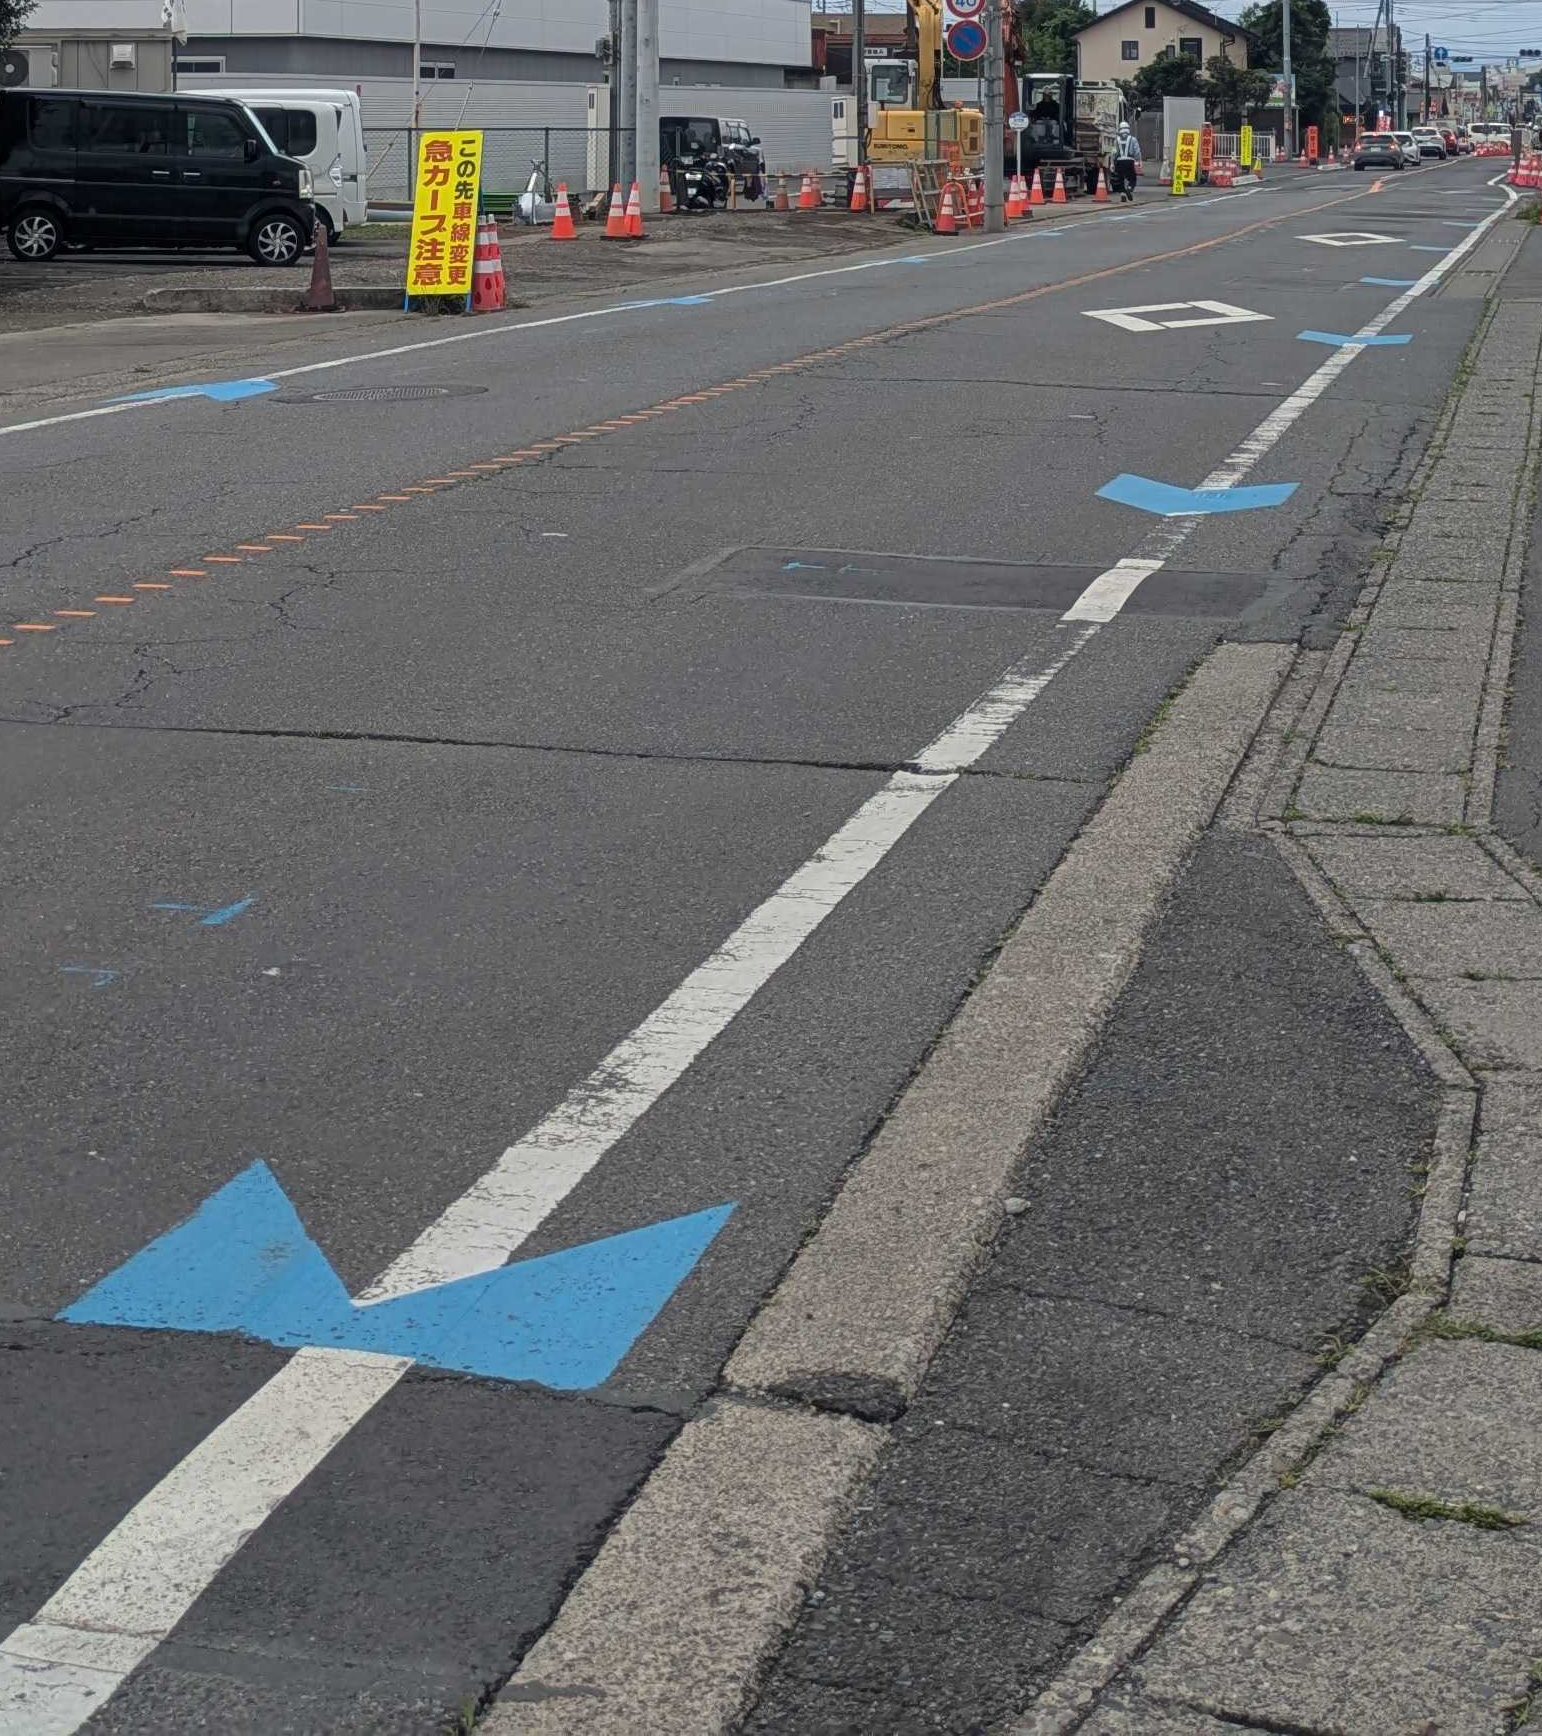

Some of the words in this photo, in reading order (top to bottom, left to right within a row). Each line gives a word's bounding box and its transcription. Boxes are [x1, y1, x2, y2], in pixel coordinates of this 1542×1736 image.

[412, 139, 454, 286] 急カーブ注意
[446, 139, 476, 286] この先車線変更
[1177, 132, 1195, 179] 最徐行
